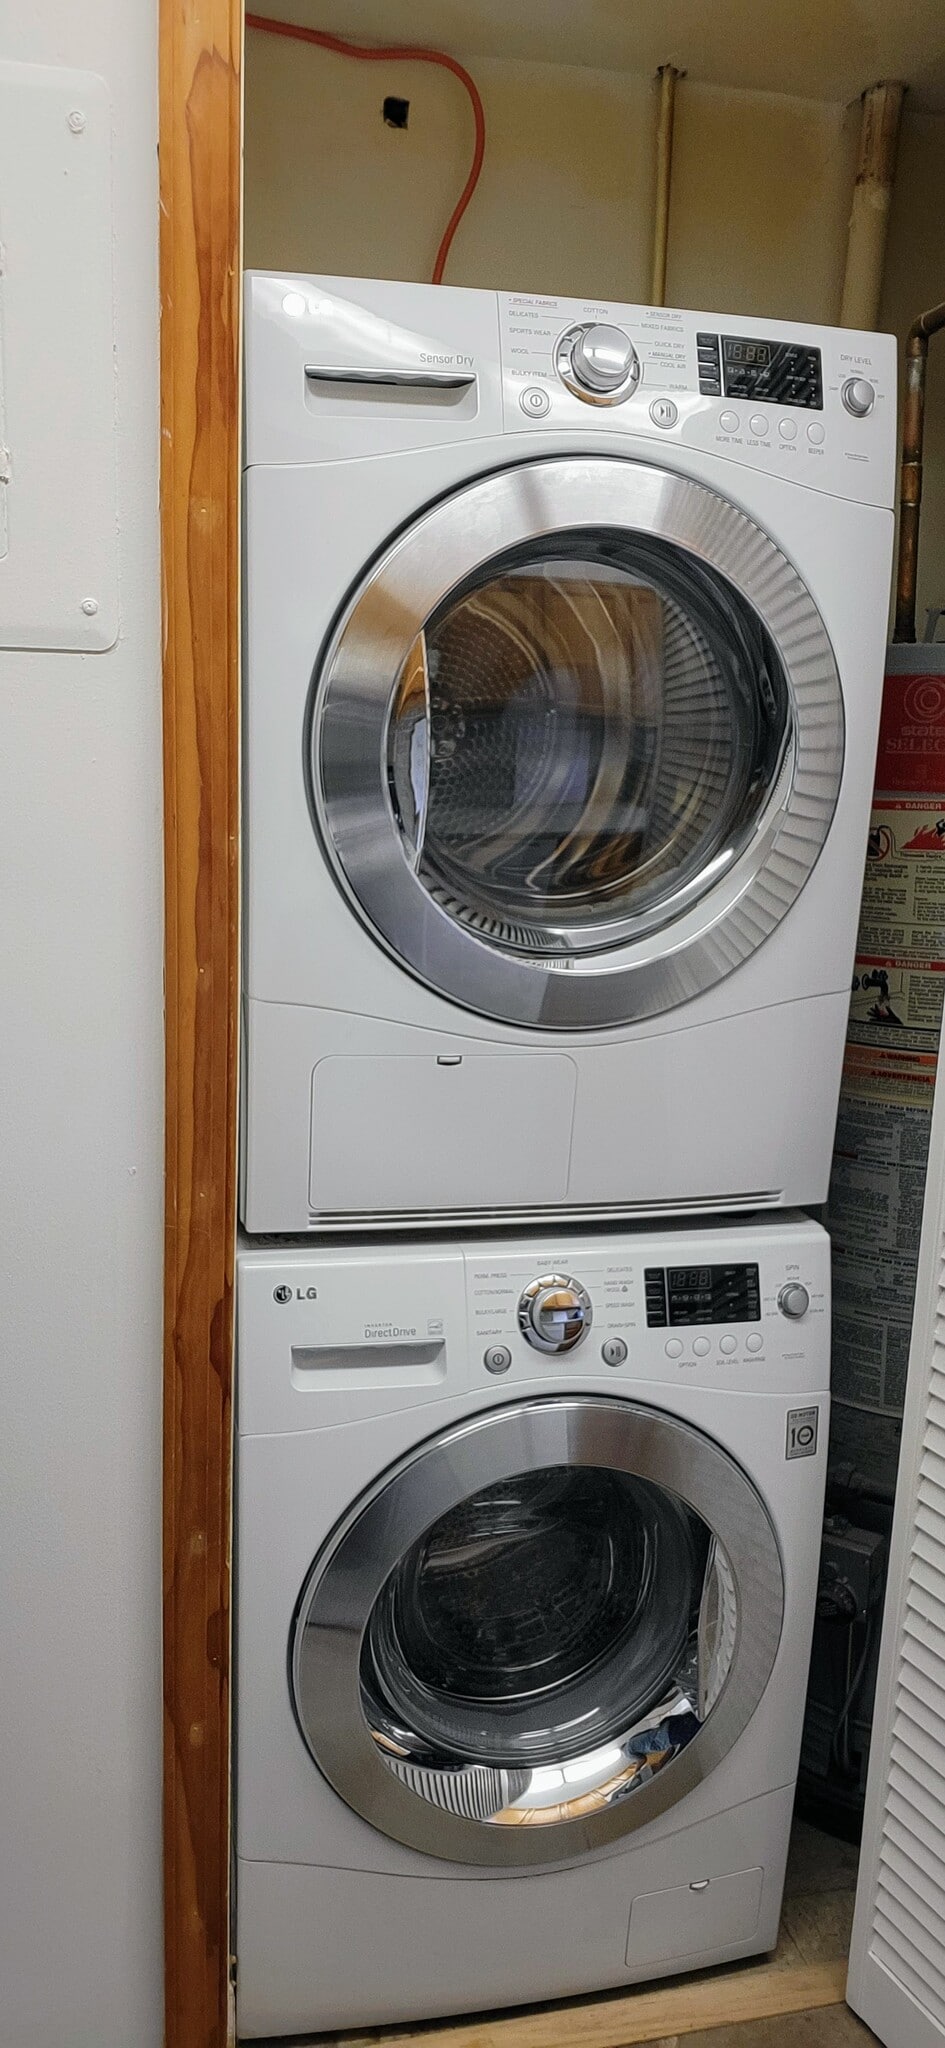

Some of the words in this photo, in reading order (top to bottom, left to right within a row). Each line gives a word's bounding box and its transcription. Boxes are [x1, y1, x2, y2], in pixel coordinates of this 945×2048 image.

[508, 310, 539, 318] DELICATES
[420, 352, 454, 364] Sensor
[456, 355, 474, 367] Dry
[840, 354, 853, 362] DRY
[854, 356, 872, 366] LEVEL
[778, 444, 797, 452] OPTION
[296, 1287, 317, 1300] LG
[792, 1425, 814, 1448] 10
